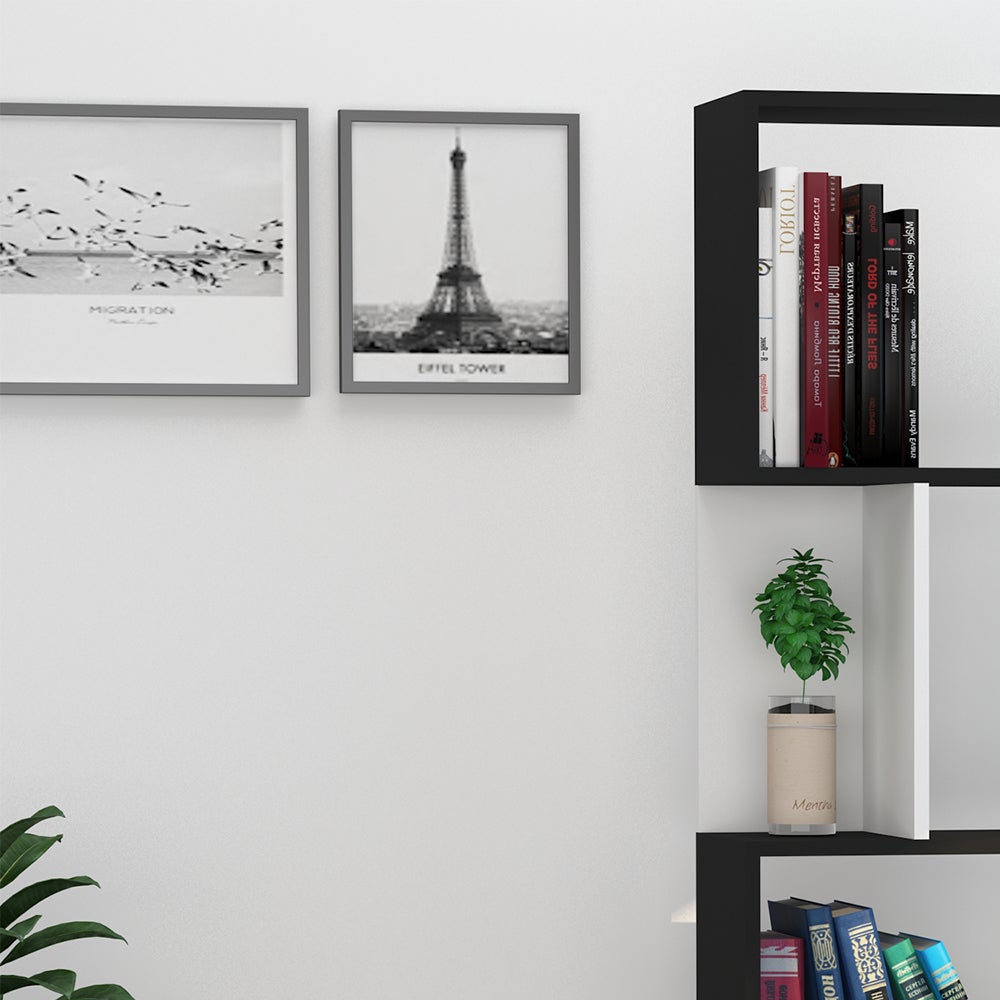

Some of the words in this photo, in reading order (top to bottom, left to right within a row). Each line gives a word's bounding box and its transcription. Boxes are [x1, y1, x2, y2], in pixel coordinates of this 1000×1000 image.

[89, 305, 175, 315] MIGRATION
[418, 363, 455, 375] EIFFEL
[459, 363, 505, 375] TOWER
